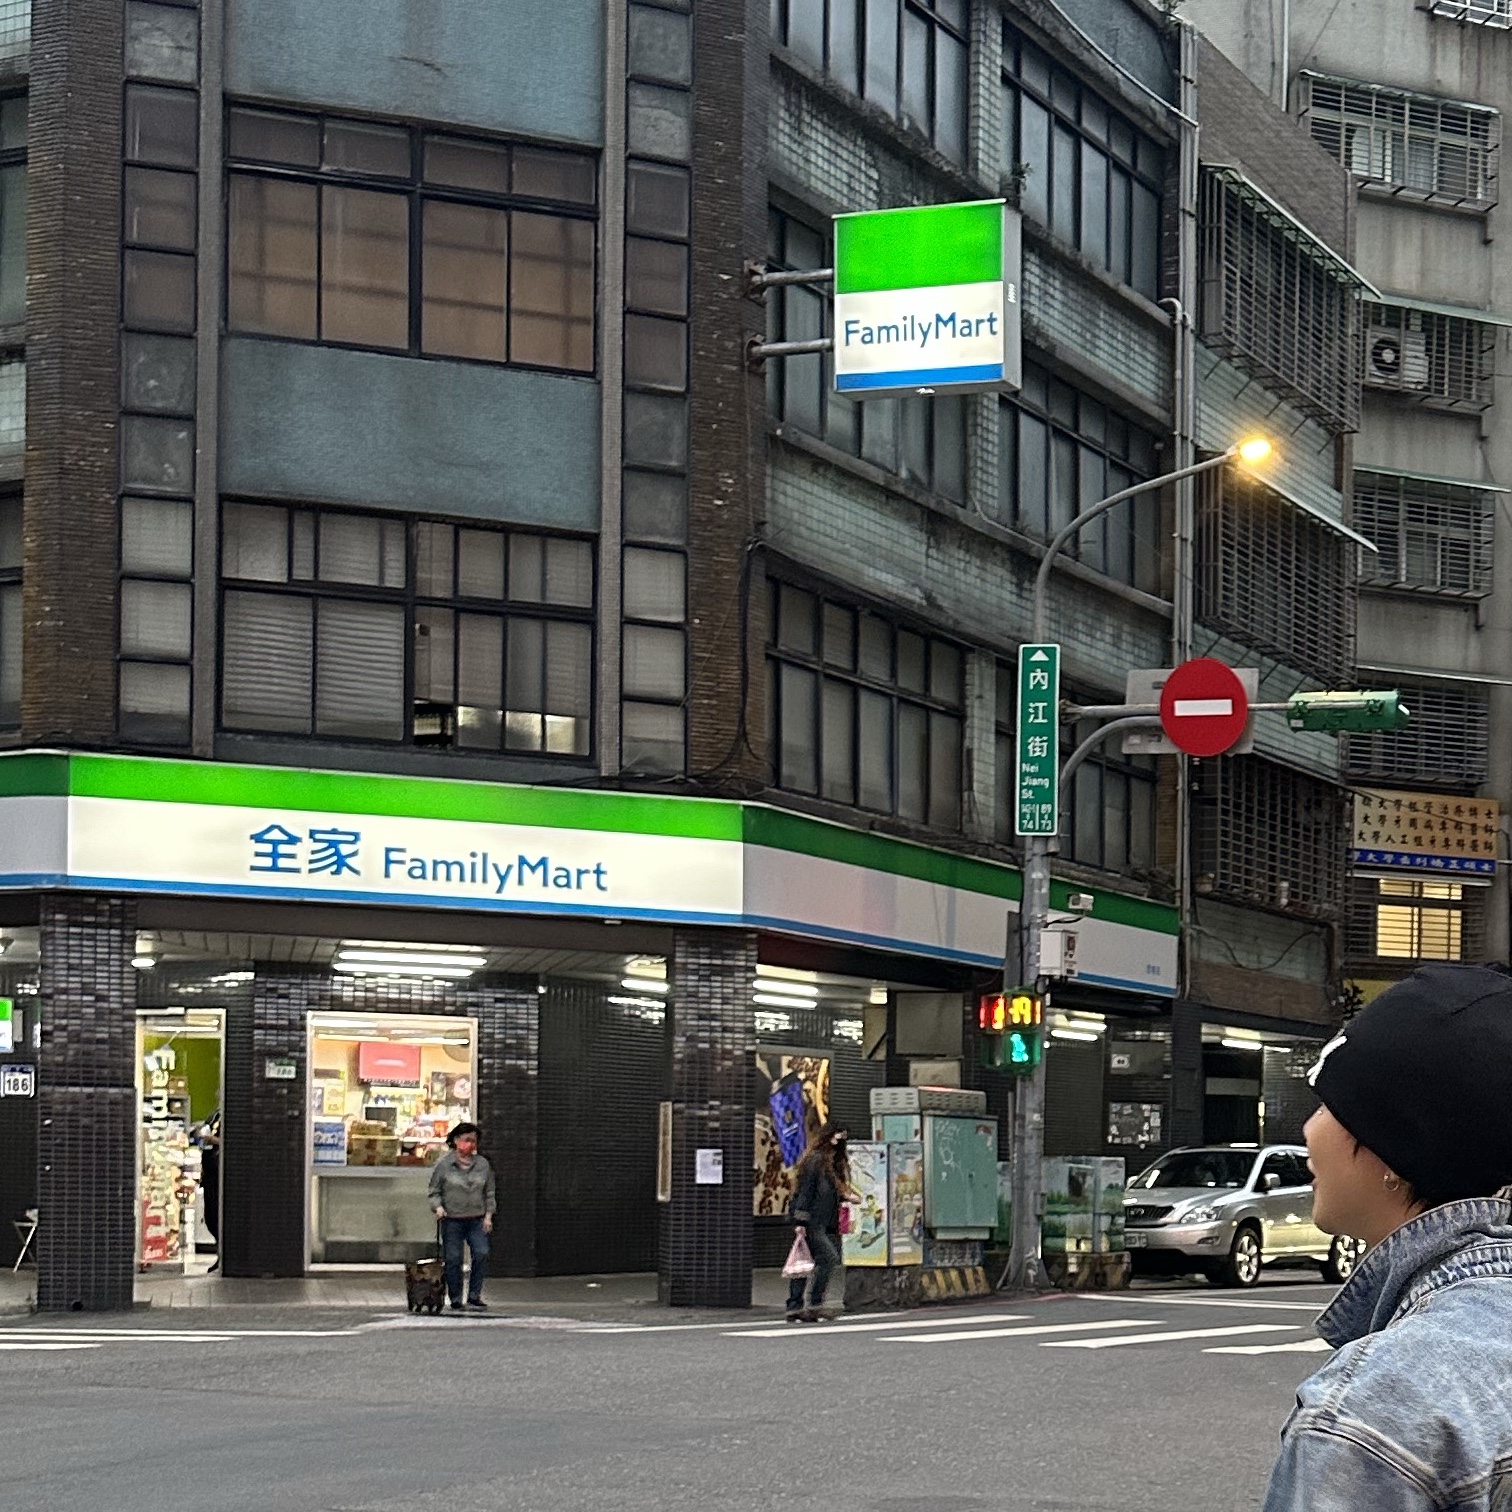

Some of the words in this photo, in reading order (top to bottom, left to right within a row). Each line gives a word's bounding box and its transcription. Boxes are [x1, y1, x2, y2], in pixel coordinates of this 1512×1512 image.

[844, 312, 998, 349] FamilyMart
[1027, 668, 1049, 758] 內江街
[1021, 763, 1039, 773] Nei
[1021, 776, 1050, 788] Jiang
[249, 824, 362, 877] 全家
[383, 847, 608, 894] FamilyMart
[6, 1077, 30, 1092] 186
